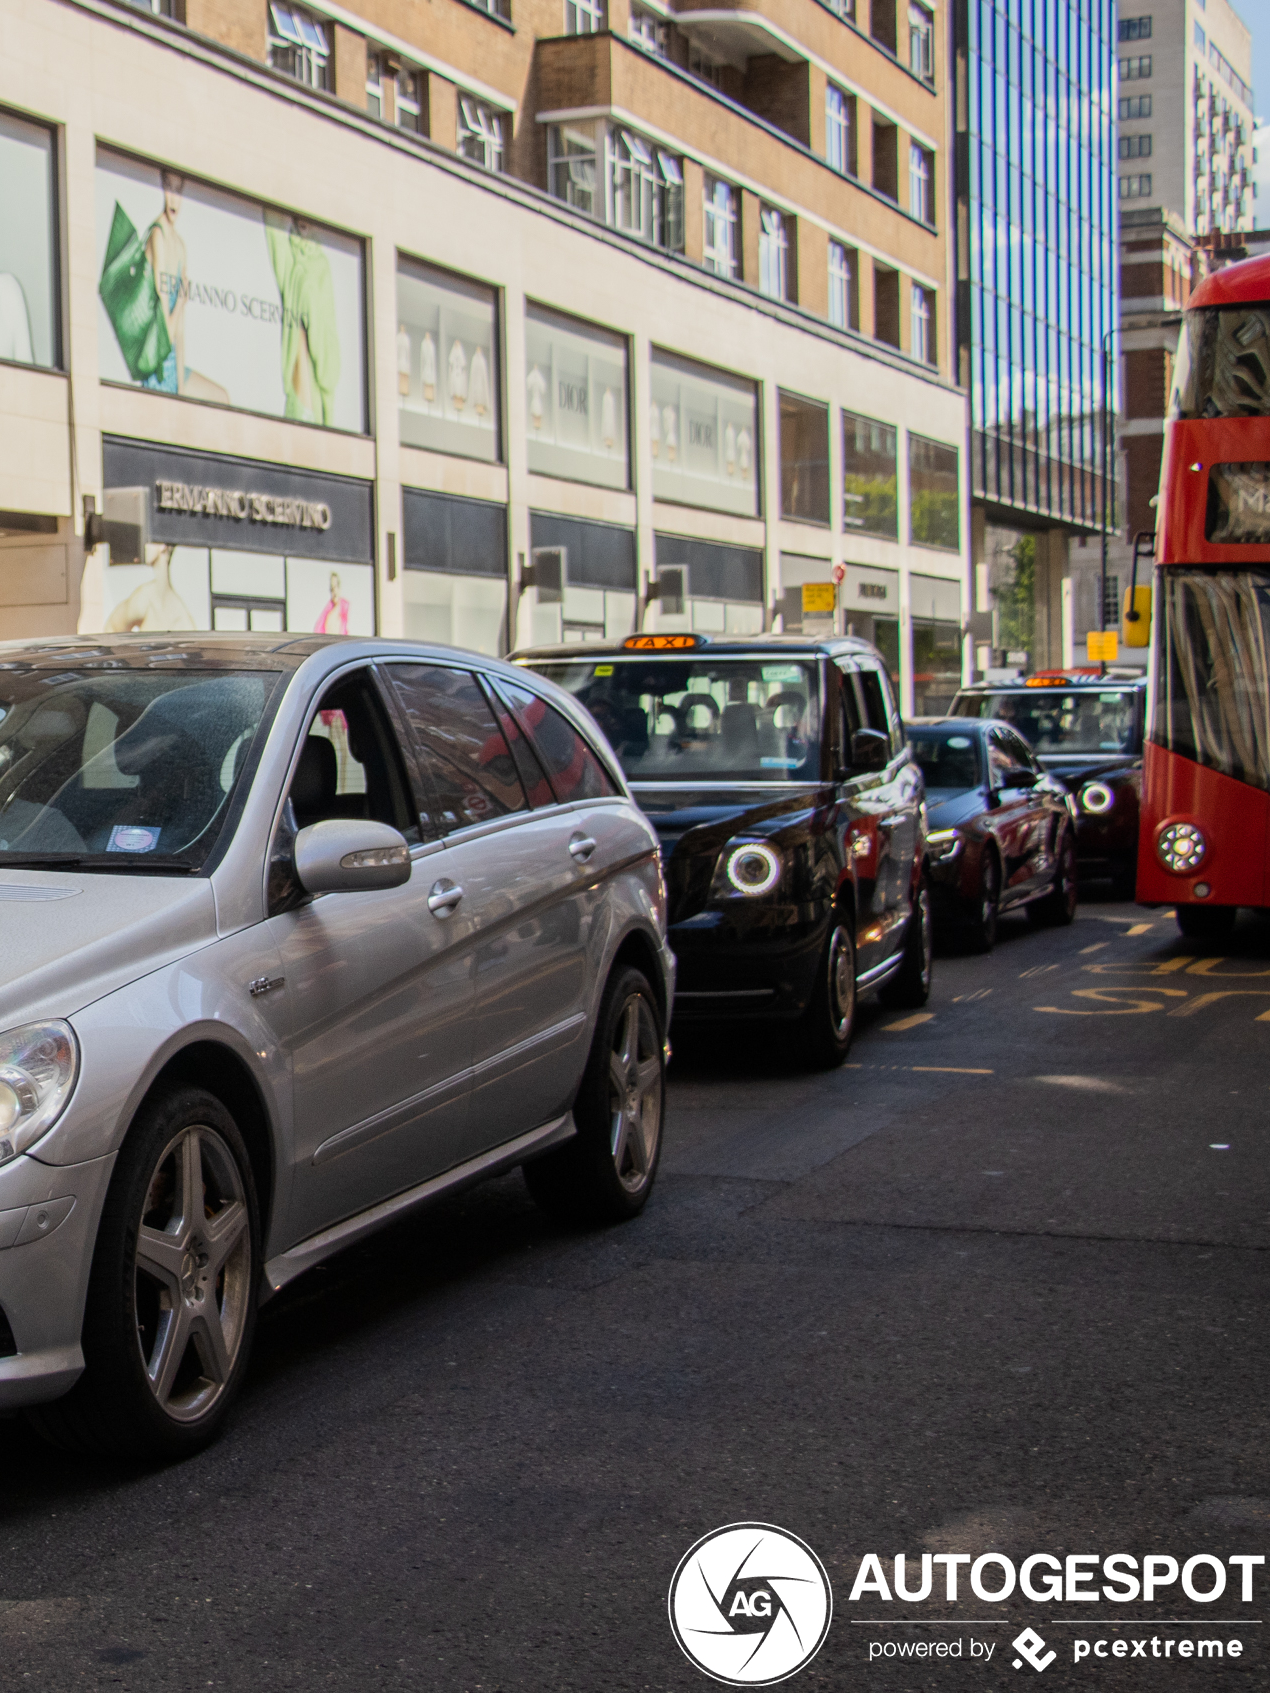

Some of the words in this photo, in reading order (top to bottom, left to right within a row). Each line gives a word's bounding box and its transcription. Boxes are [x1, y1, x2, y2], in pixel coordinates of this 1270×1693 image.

[159, 271, 237, 313] ERMANNO
[240, 293, 310, 331] SCERVINO
[558, 380, 588, 417] DIOR
[156, 479, 249, 519] ERMANNO
[249, 492, 332, 531] SCERVINO
[630, 637, 690, 648] TAXI
